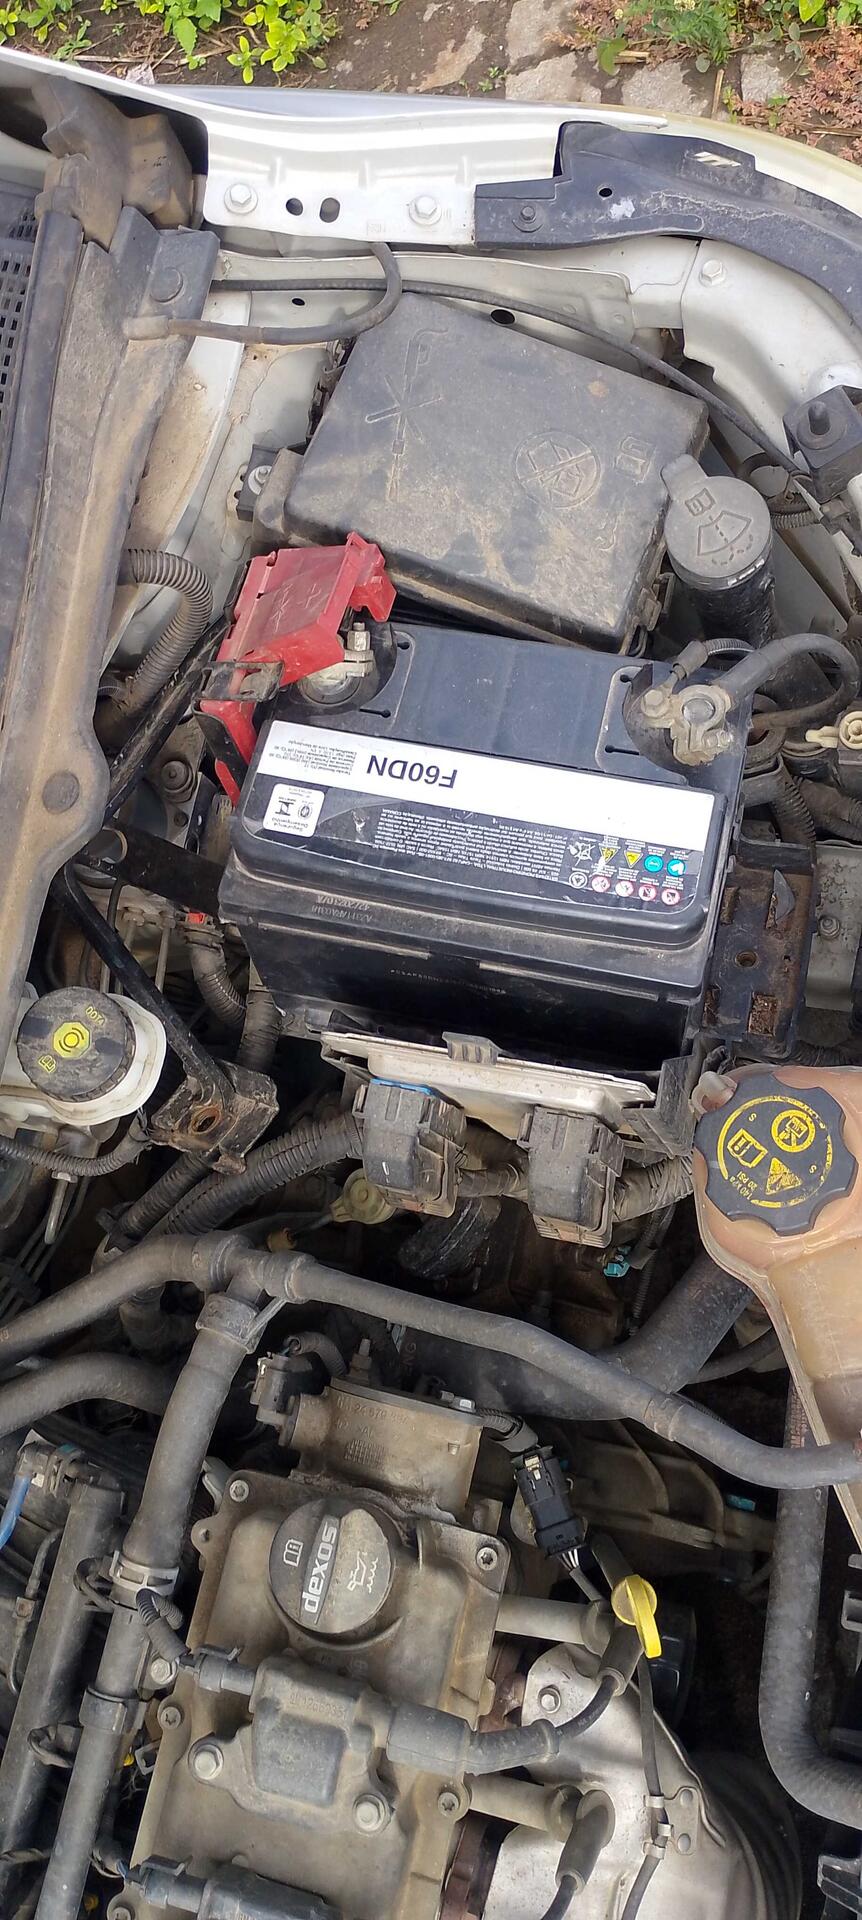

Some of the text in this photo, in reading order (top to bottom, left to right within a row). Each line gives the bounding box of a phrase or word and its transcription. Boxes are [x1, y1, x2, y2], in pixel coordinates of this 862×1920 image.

[367, 754, 457, 789] F60DN
[736, 1171, 749, 1184] PSI
[740, 1187, 753, 1200] 140
[301, 1522, 338, 1614] dexos
